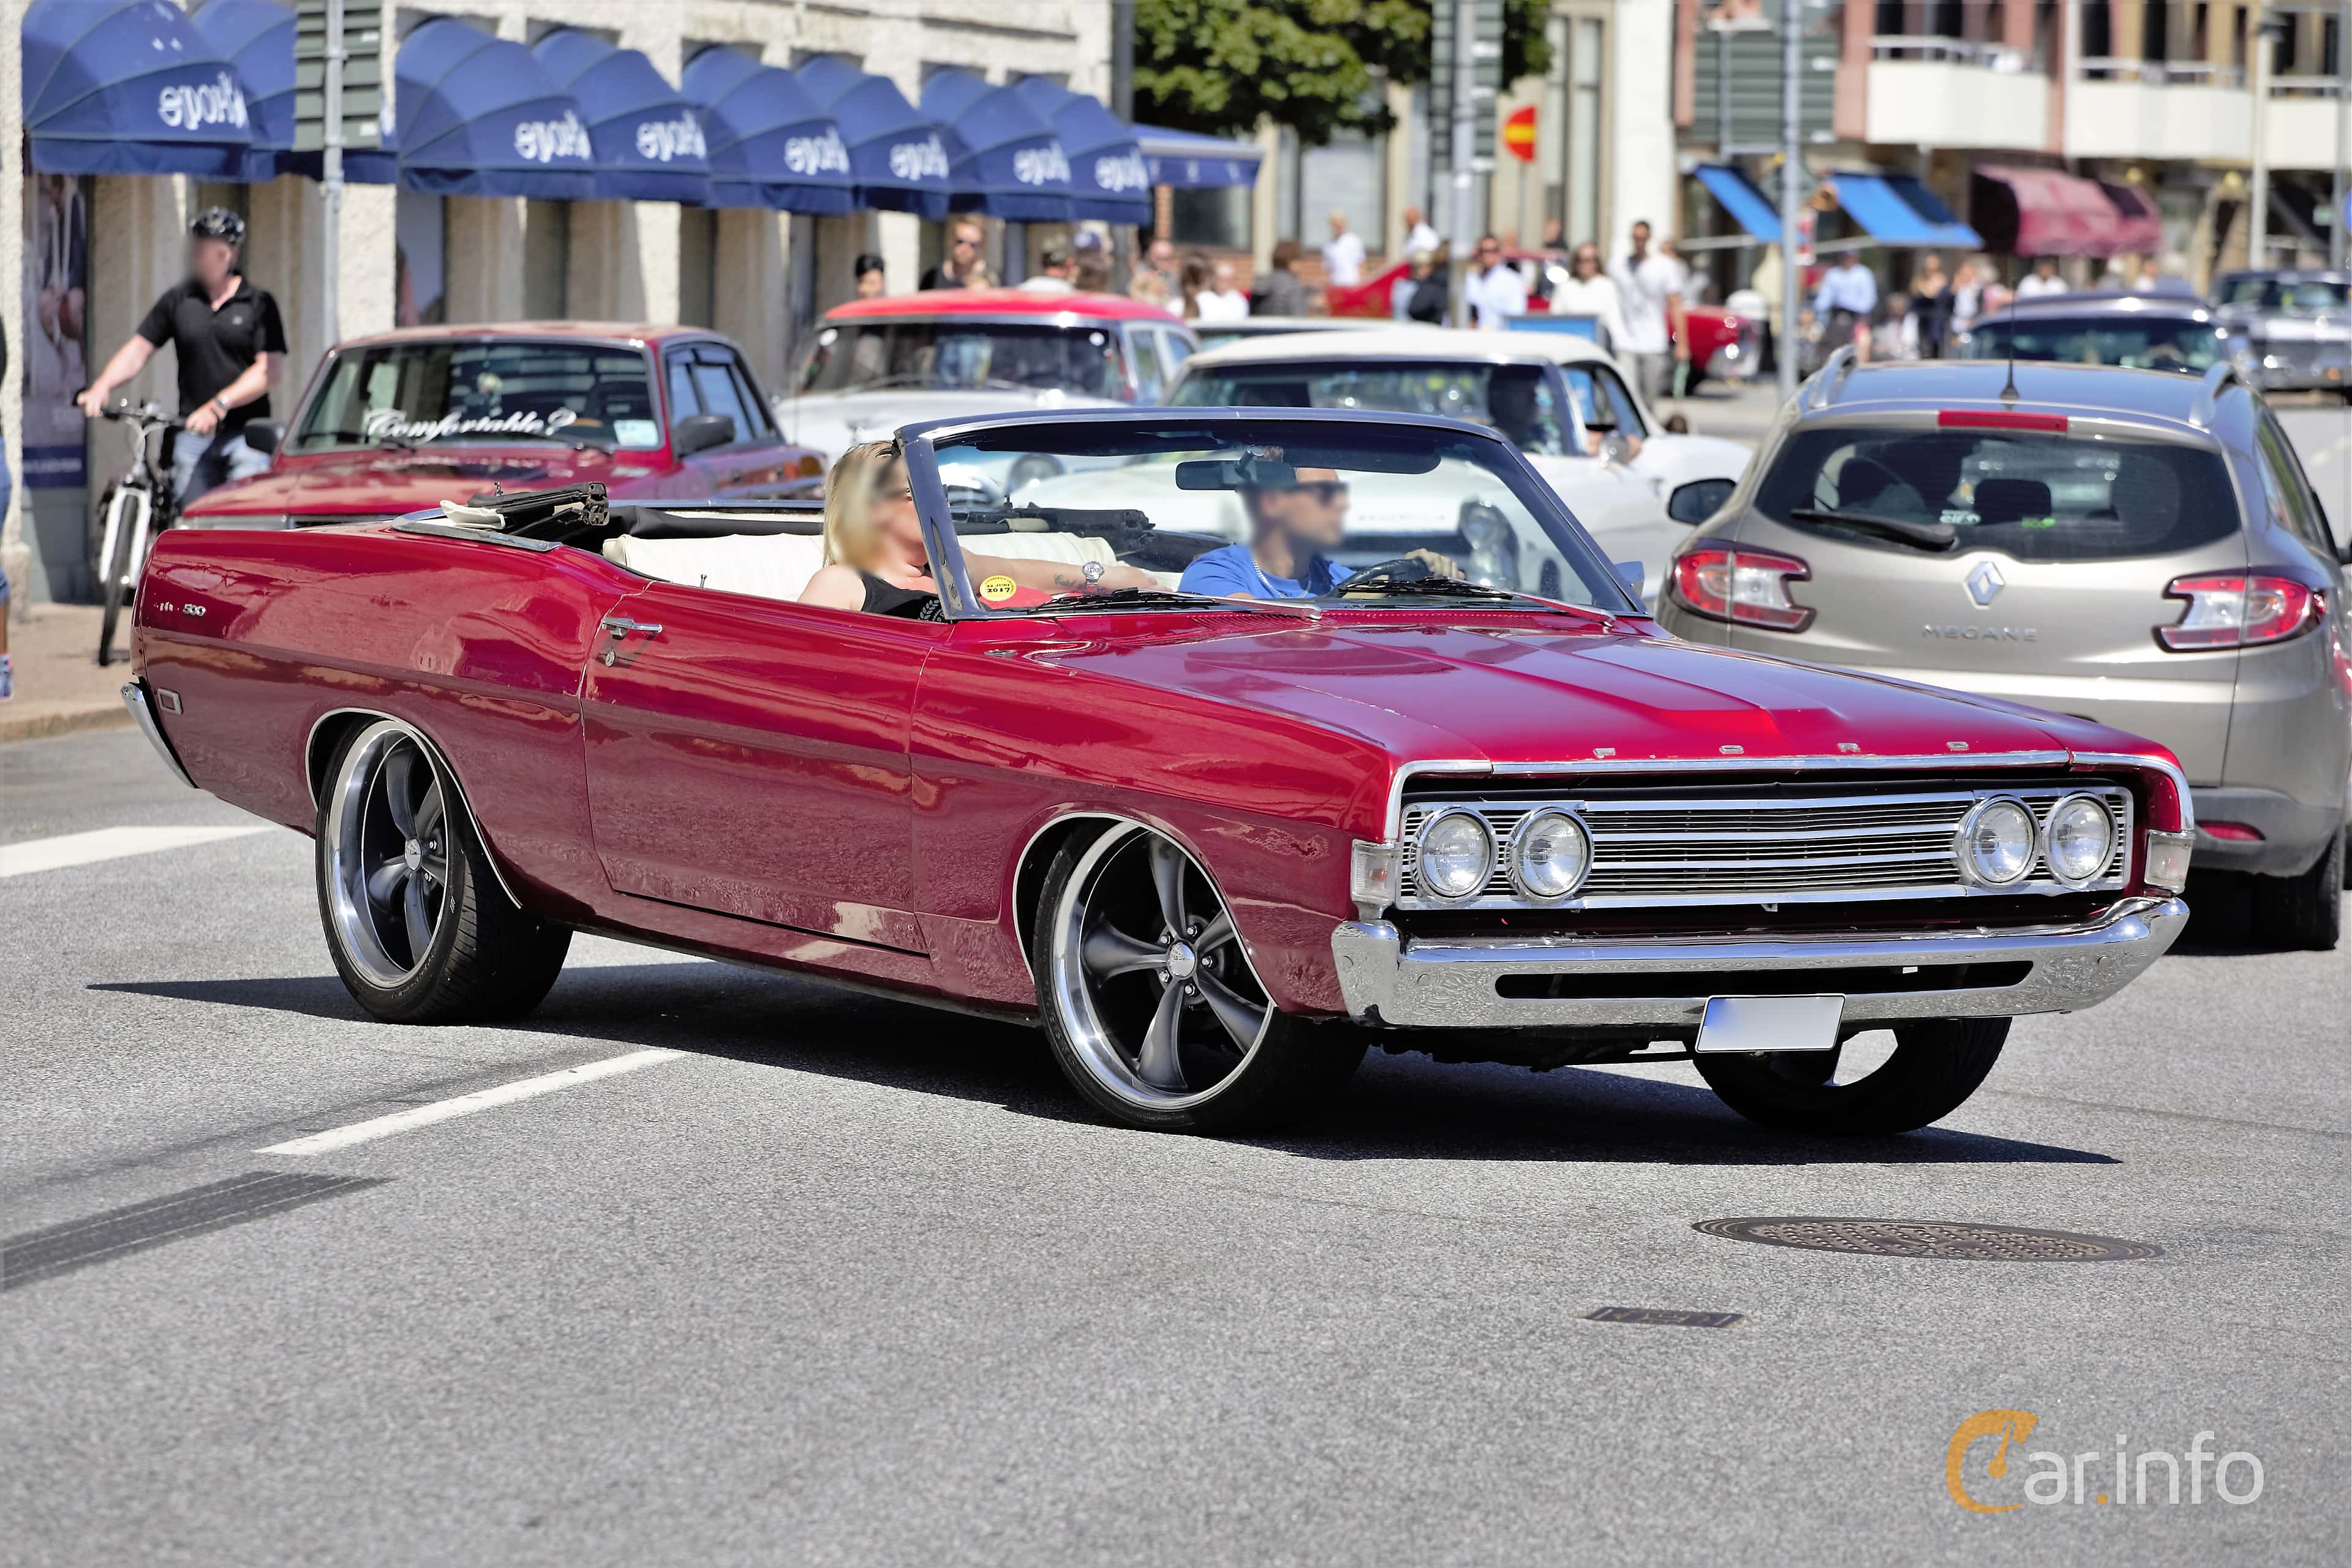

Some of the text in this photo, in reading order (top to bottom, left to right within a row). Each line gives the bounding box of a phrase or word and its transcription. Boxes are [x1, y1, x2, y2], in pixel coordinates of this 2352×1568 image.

[363, 407, 577, 445] Comfortable?
[183, 603, 206, 617] 500
[1921, 624, 2037, 643] MEGANE
[1594, 741, 1970, 758] FORD
